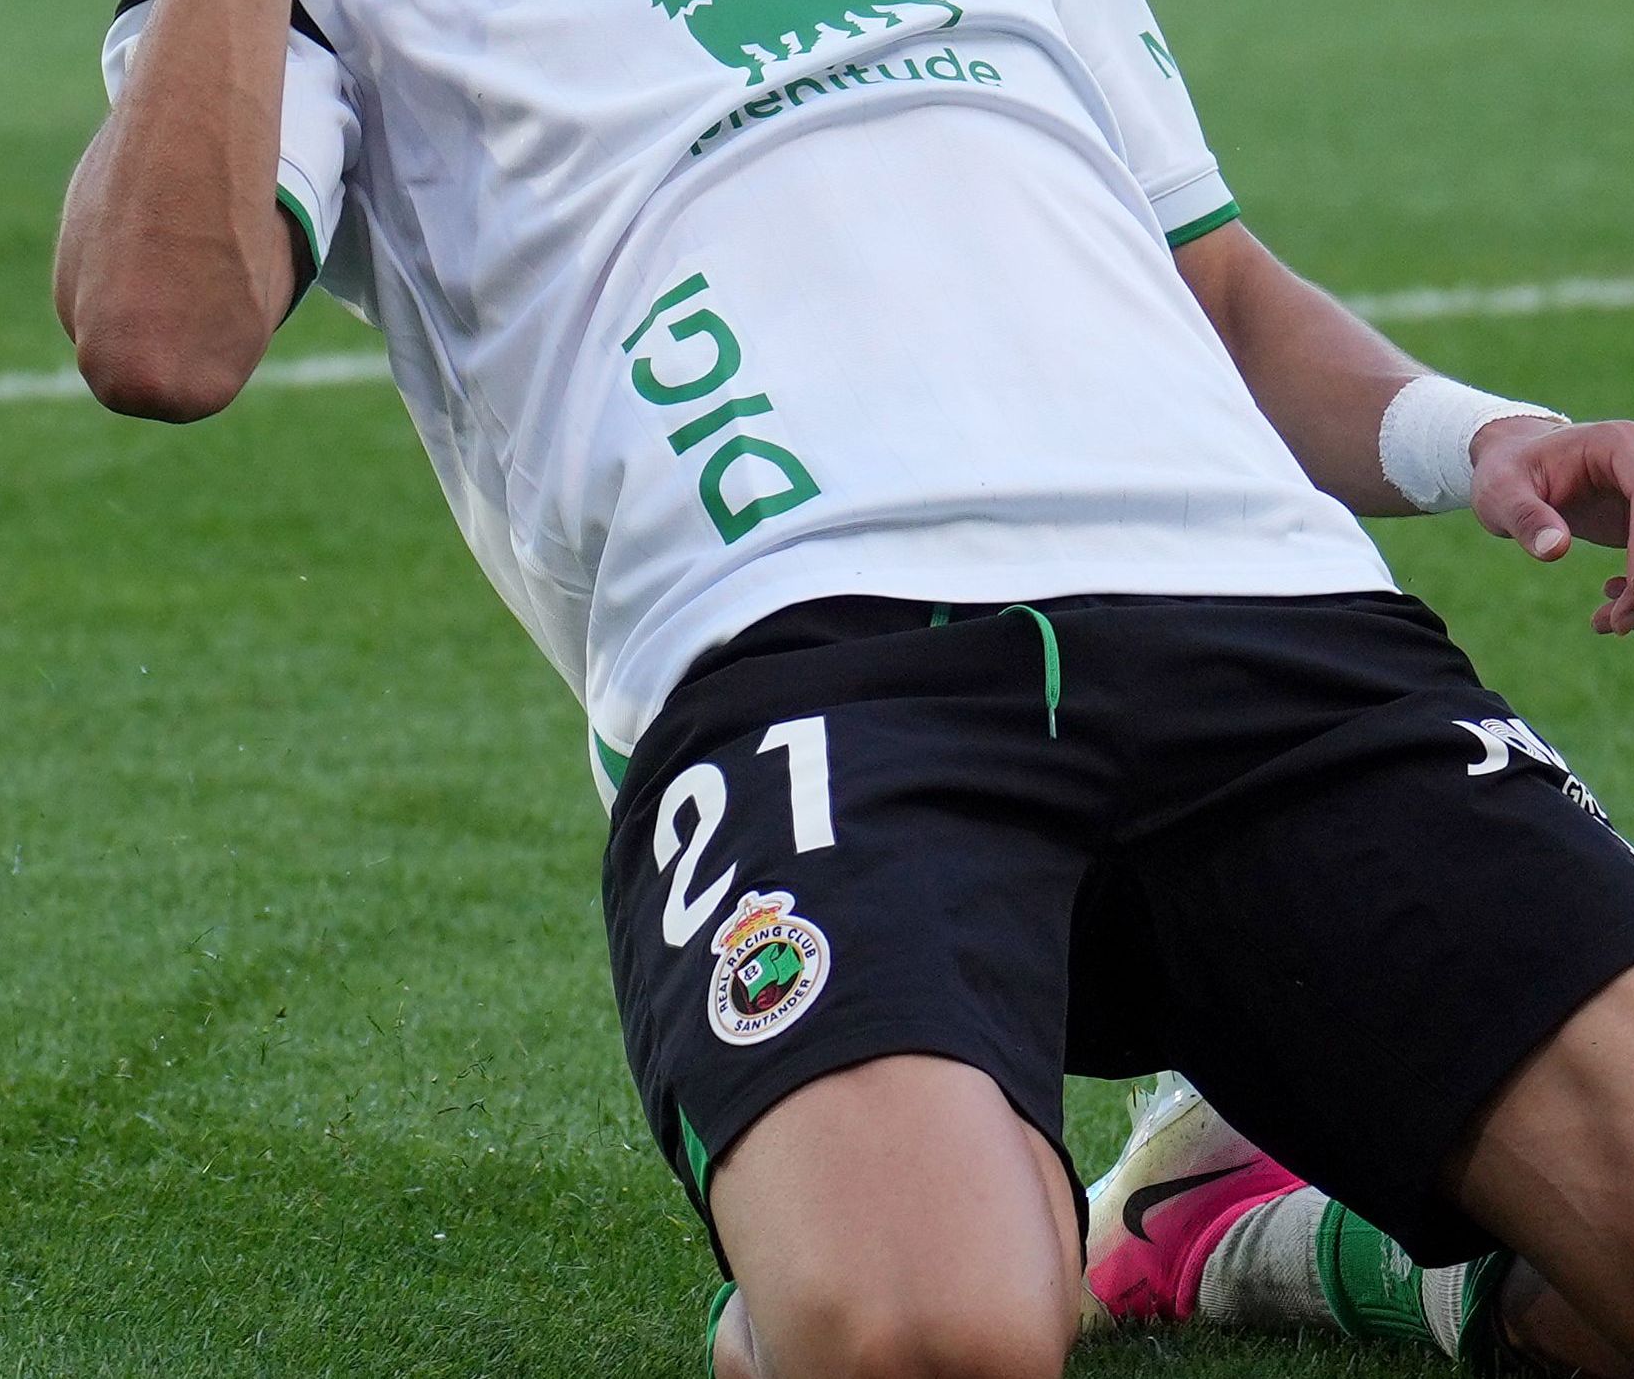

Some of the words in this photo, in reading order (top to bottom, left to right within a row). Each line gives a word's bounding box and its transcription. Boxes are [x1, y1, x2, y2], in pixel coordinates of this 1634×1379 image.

[621, 271, 821, 546] DIGI
[652, 714, 836, 948] 21
[718, 973, 732, 1013] REAL
[727, 926, 782, 968] RACING
[787, 928, 817, 959] CLUB
[733, 978, 811, 1032] SANTANDER
